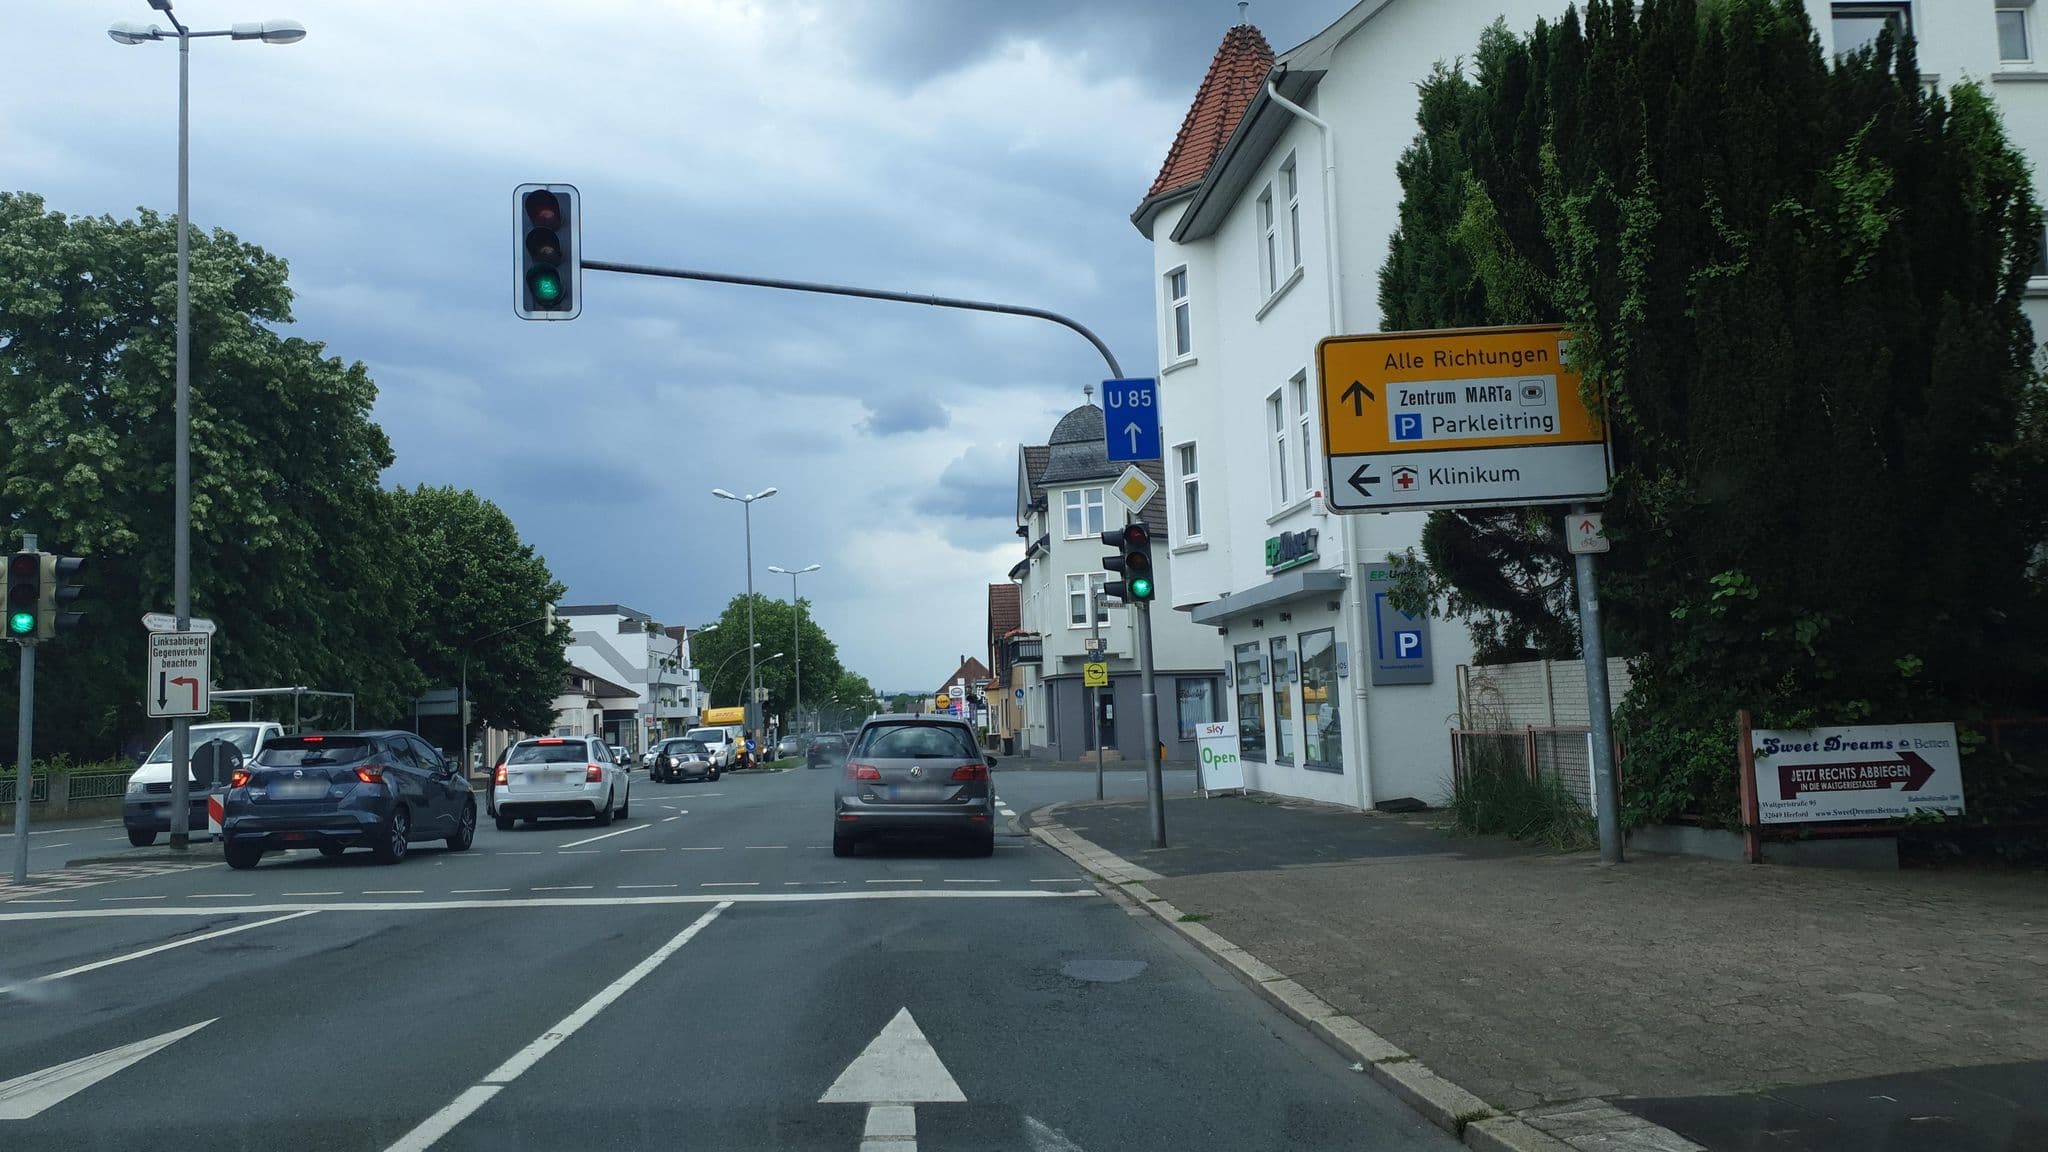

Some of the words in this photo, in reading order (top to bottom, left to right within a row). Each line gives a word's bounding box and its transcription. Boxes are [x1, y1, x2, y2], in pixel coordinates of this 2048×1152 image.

[1384, 352, 1424, 371] Alle
[1434, 347, 1548, 368] Richtungen
[1109, 390, 1122, 408] U
[1128, 389, 1151, 407] 85
[1399, 388, 1456, 407] Zentrum
[1465, 386, 1512, 403] MARTa
[1400, 417, 1416, 436] P
[1432, 412, 1554, 434] Parkleitring
[1428, 465, 1521, 486] Klinikum
[153, 636, 207, 647] Linksabbieger
[1399, 632, 1418, 657] P
[152, 647, 206, 658] Gegenverkehr
[161, 659, 198, 668] beachten
[1206, 725, 1225, 735] sky
[1763, 738, 1819, 755] Sweet
[1823, 735, 1894, 752] Dreams
[1202, 747, 1237, 770] Open
[1791, 769, 1817, 782] JETZT
[1819, 767, 1857, 780] RECHTS
[1860, 765, 1911, 778] ABBIEGEN
[1800, 783, 1808, 791] IN
[1809, 782, 1820, 790] DIE
